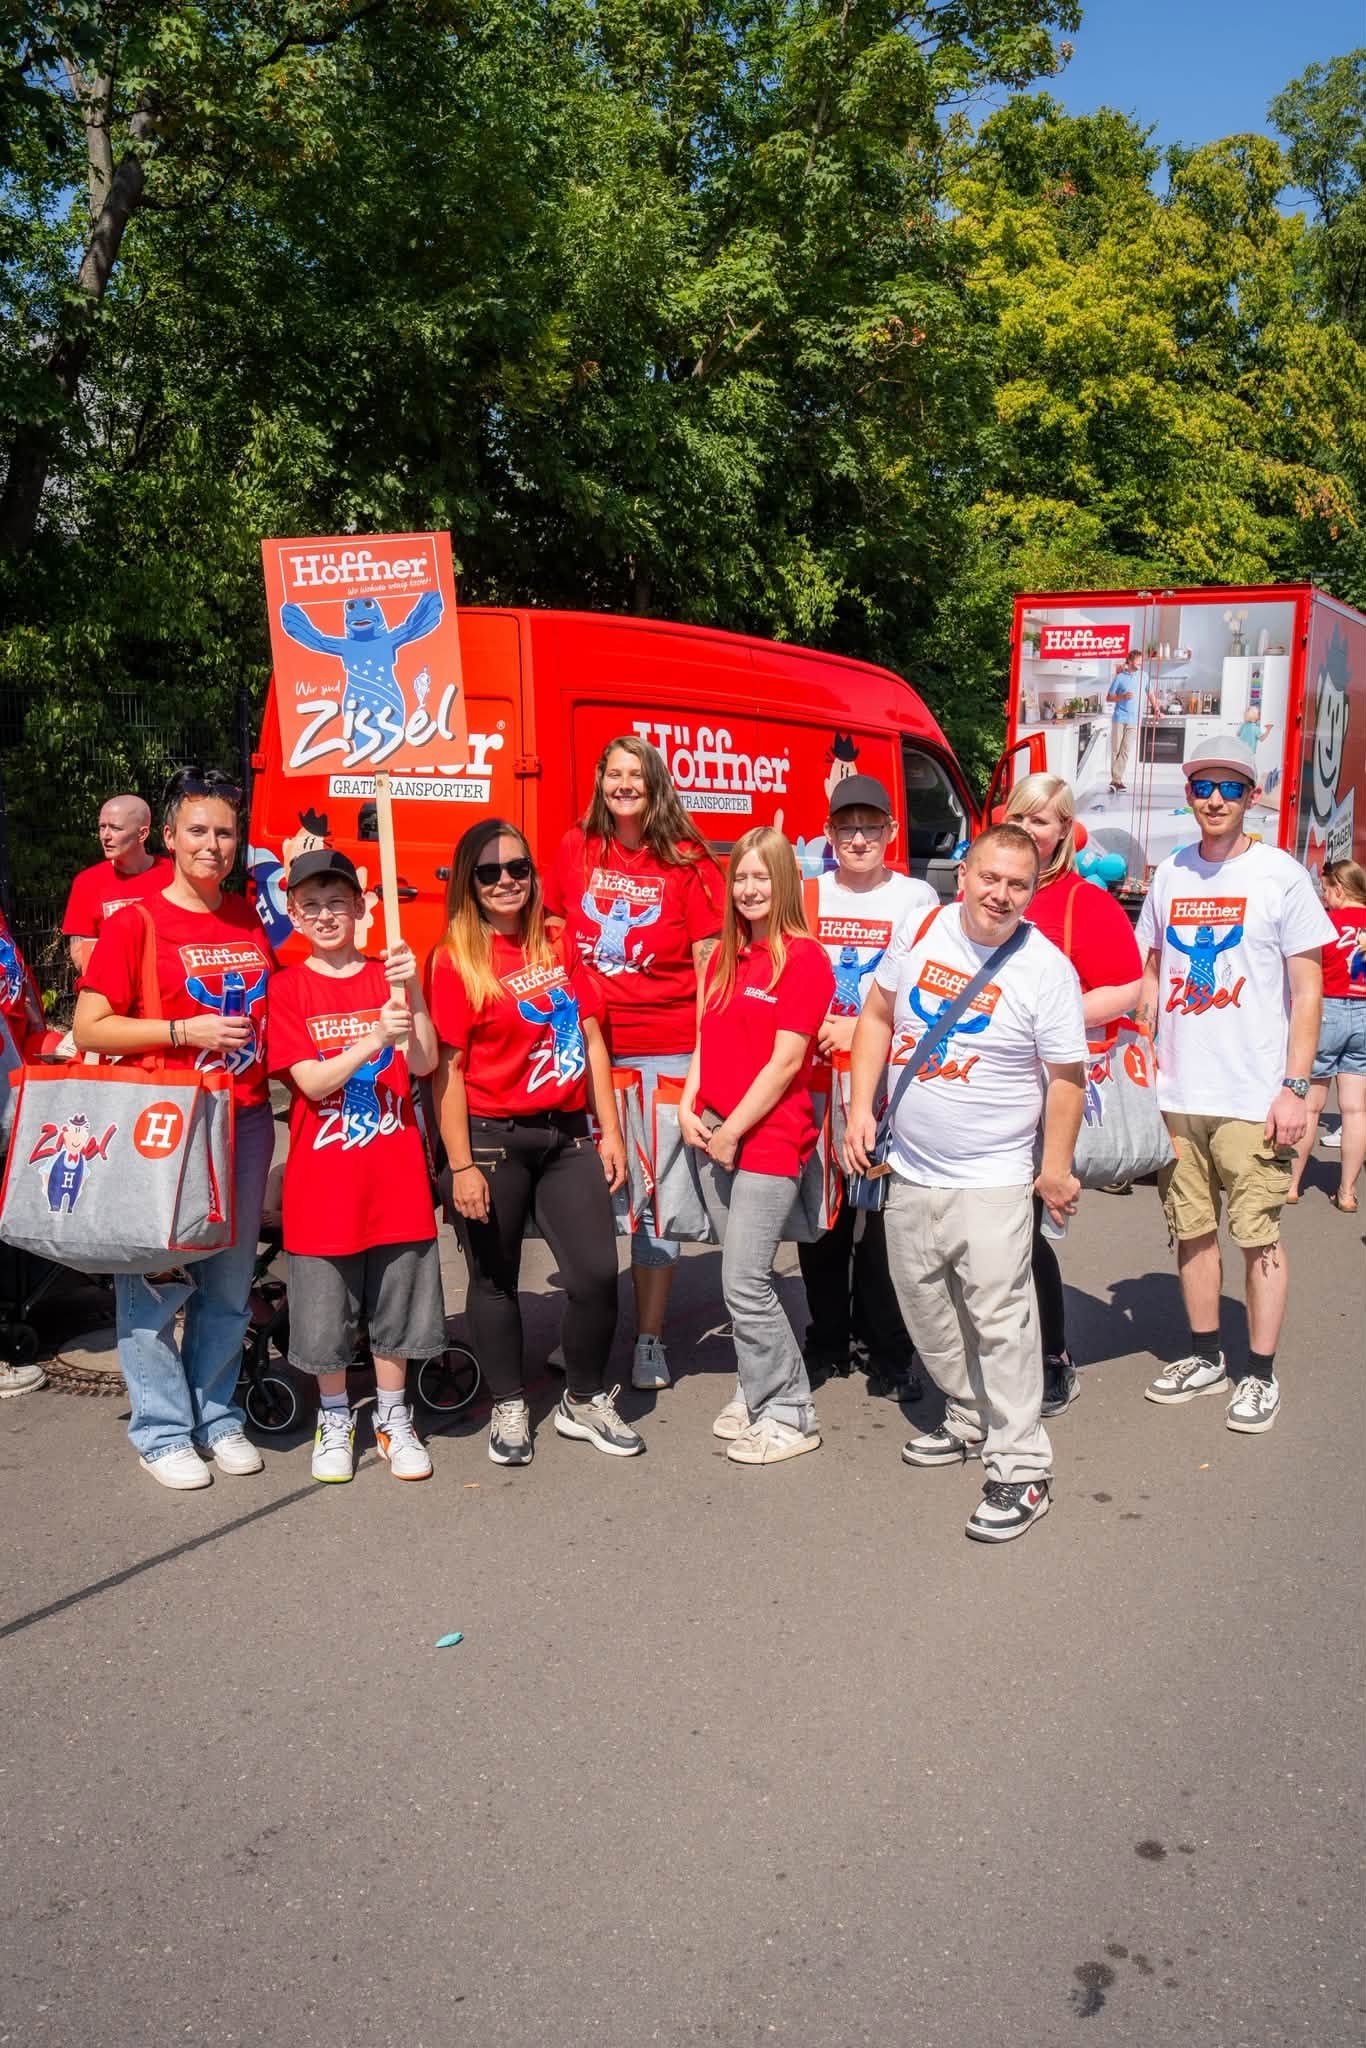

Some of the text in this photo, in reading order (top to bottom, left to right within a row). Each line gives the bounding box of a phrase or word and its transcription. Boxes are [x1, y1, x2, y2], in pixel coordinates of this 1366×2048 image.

[290, 550, 427, 587] Höffner
[1045, 630, 1125, 650] Höffner
[295, 680, 341, 697] Wir sind
[289, 683, 457, 768] Zissel
[333, 779, 484, 799] GRATIRANSPORTER
[1174, 901, 1242, 918] Höffner
[819, 920, 888, 940] Höffner
[187, 948, 260, 968] Höffner
[1166, 976, 1247, 1015] Zissel
[312, 1018, 380, 1041] Höffne
[527, 1047, 586, 1093] Ziss
[140, 1113, 177, 1148] H
[313, 1096, 405, 1151] Zissel
[28, 1122, 118, 1165] Ziel
[61, 1172, 75, 1188] H
